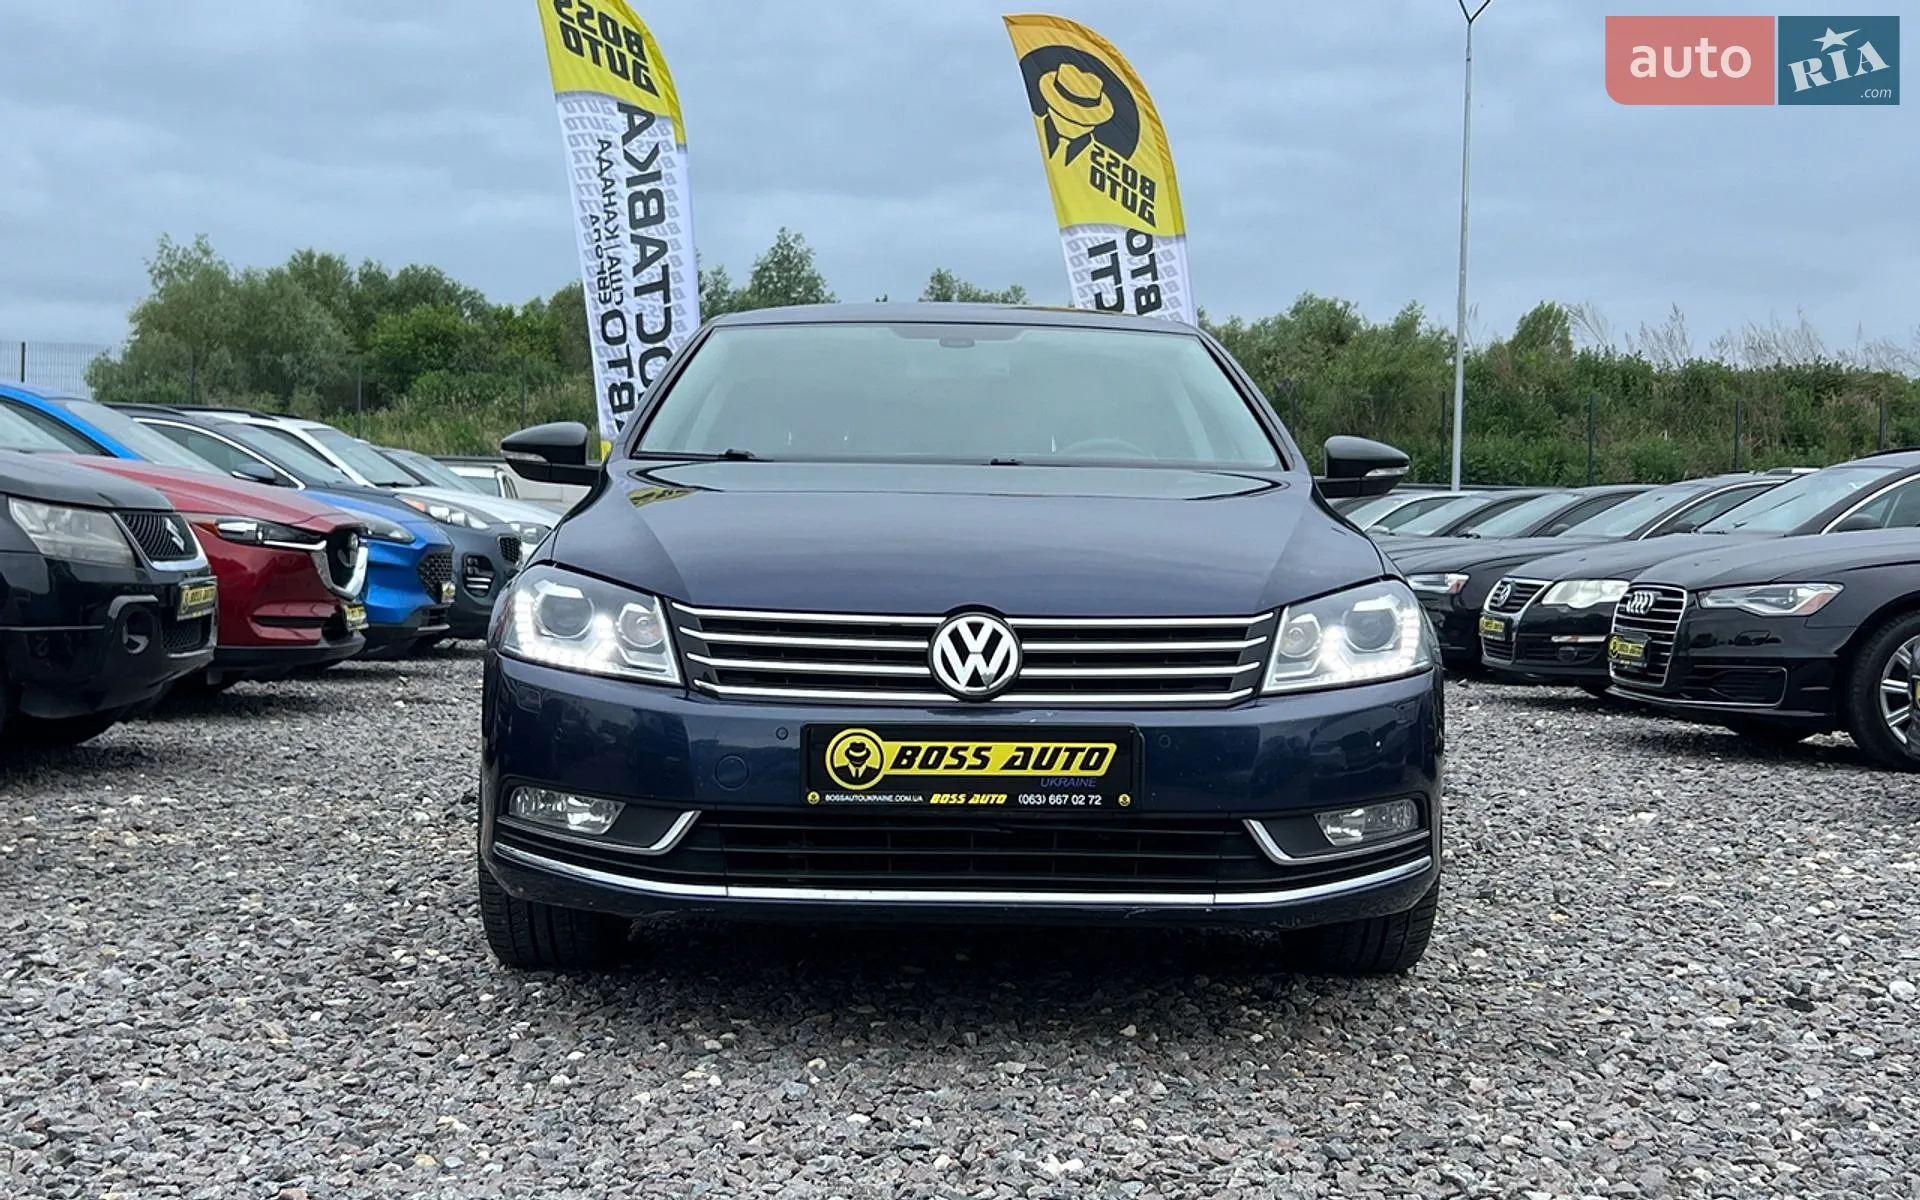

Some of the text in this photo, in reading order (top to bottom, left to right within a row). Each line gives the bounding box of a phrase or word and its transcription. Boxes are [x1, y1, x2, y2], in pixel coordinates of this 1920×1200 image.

[889, 745, 1111, 771] BOSS AUTO
[1040, 777, 1097, 788] UKRAINE
[929, 793, 966, 804] BOSS
[968, 793, 1008, 804] AUTO
[1018, 793, 1047, 806] (063)
[1048, 794, 1069, 806] 667
[1071, 794, 1086, 806] 02
[1088, 794, 1102, 806] 72
